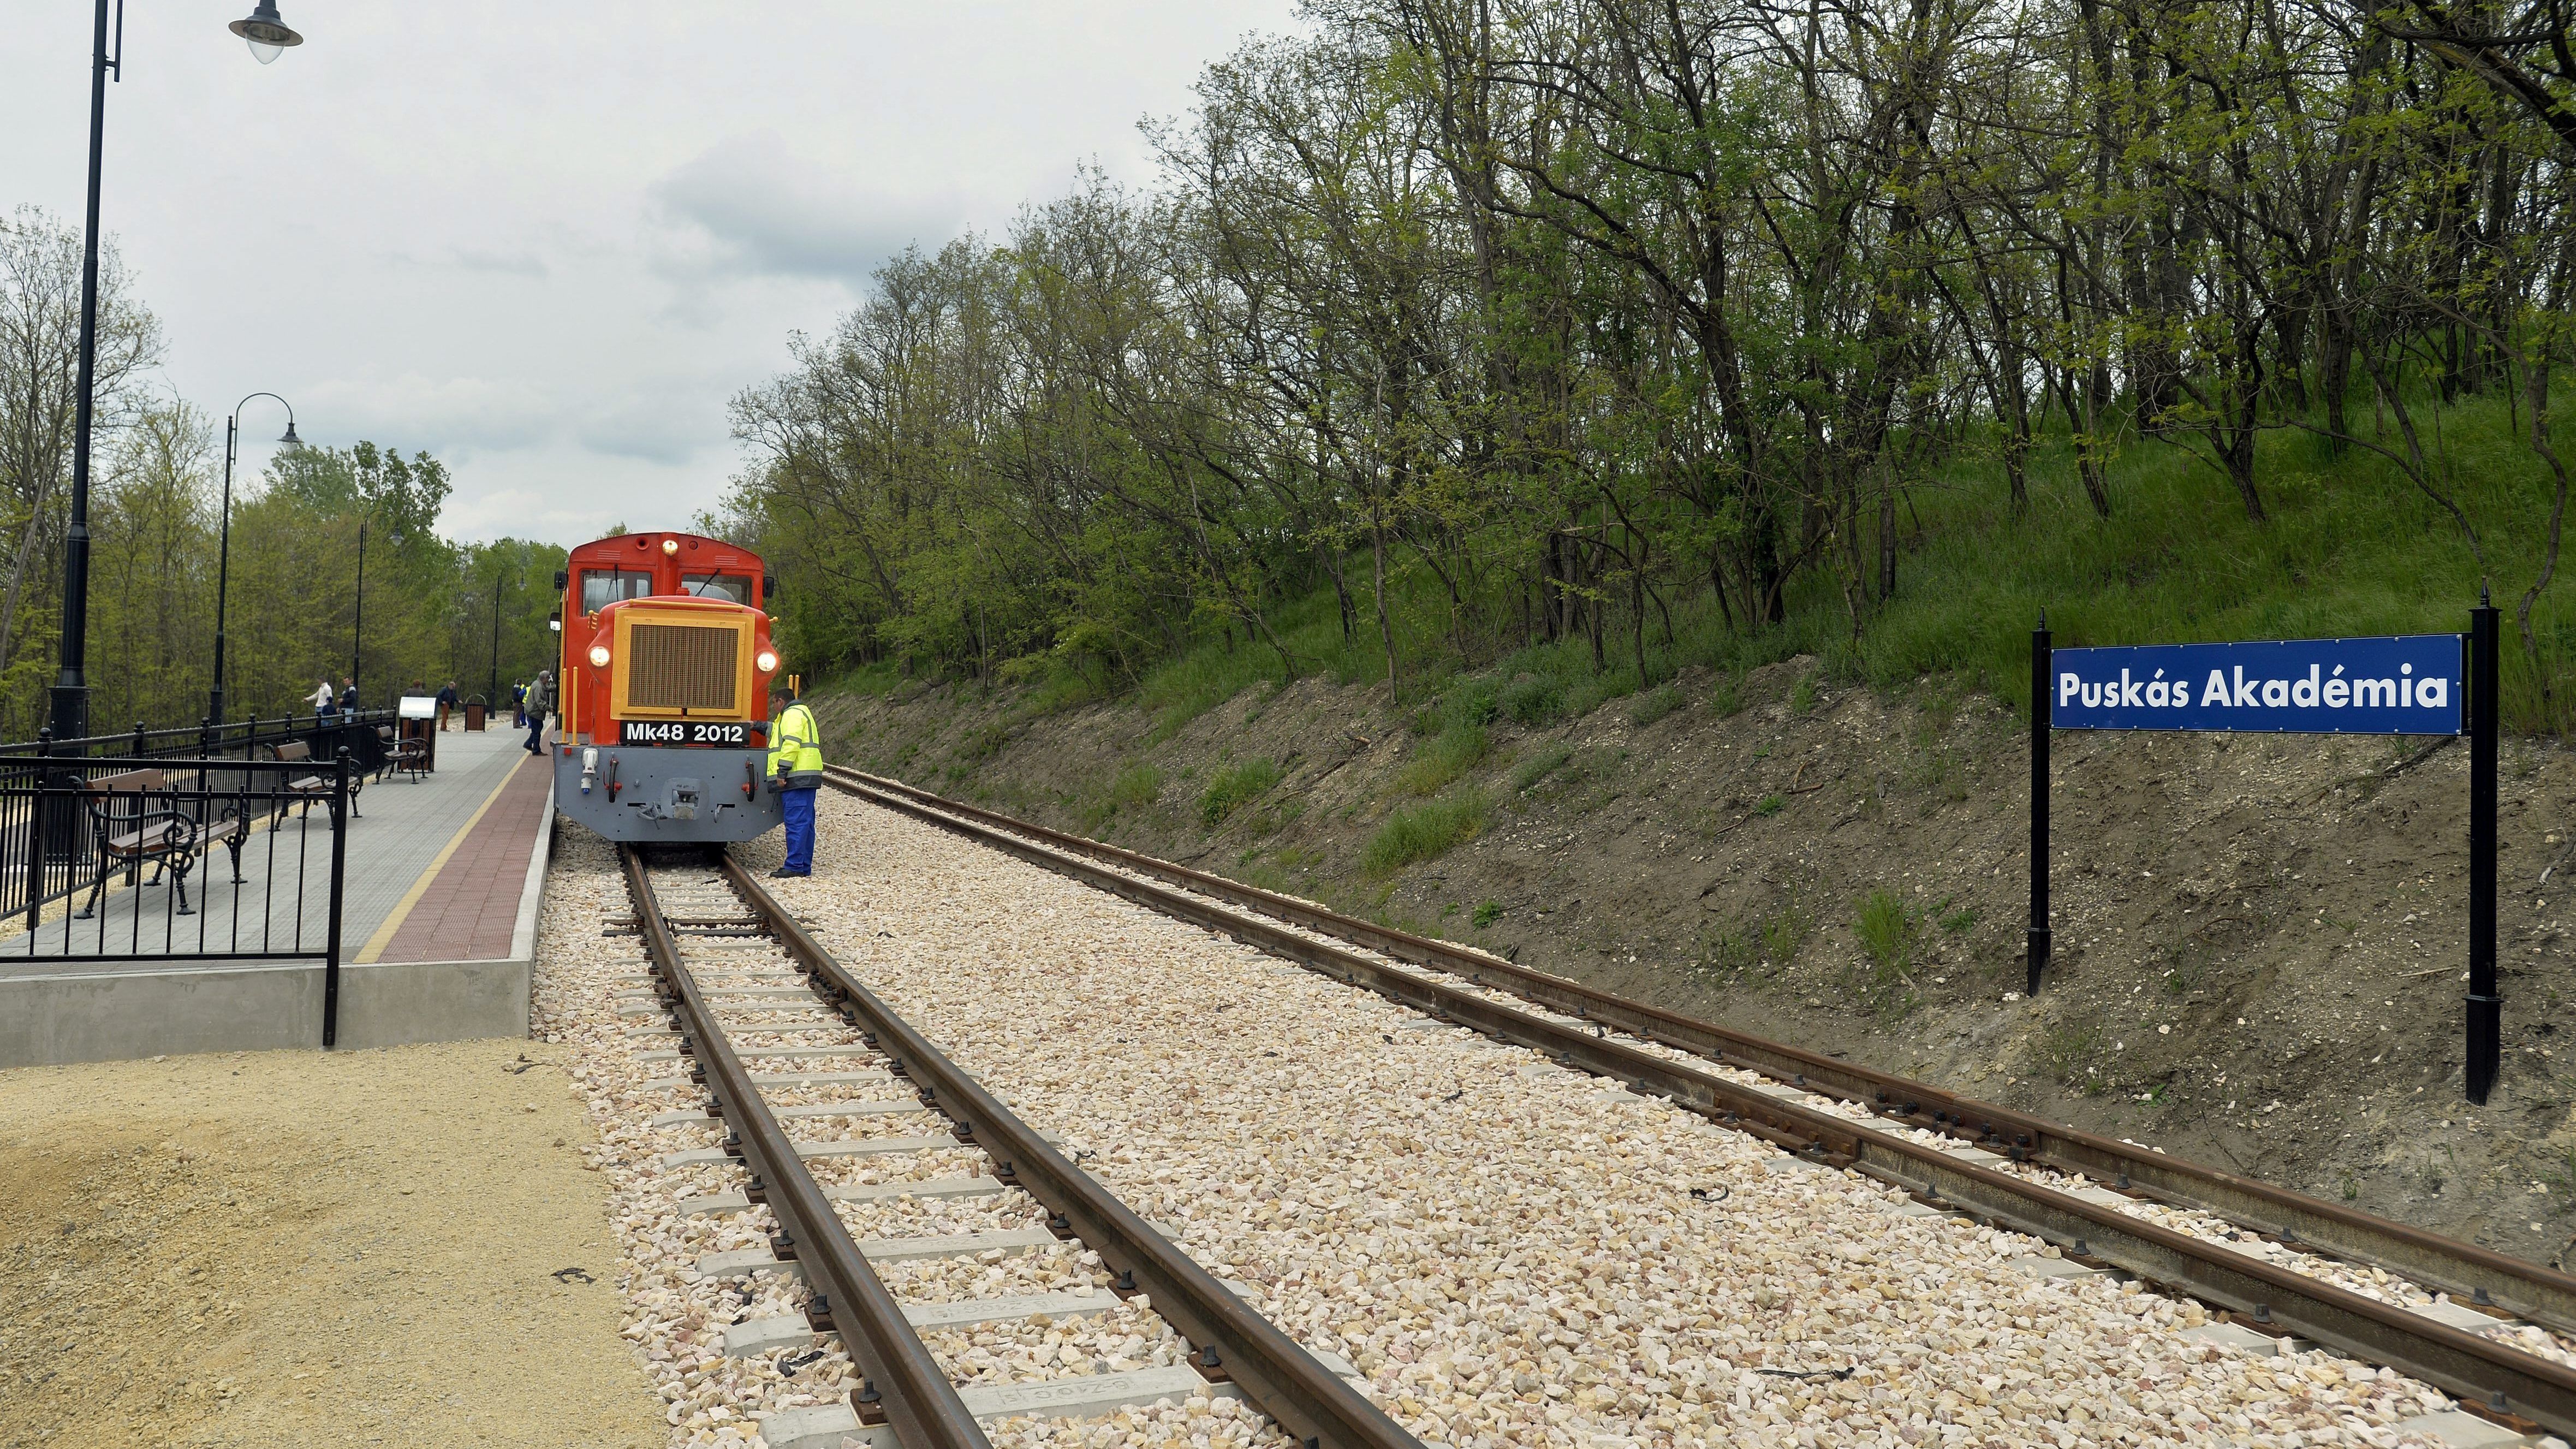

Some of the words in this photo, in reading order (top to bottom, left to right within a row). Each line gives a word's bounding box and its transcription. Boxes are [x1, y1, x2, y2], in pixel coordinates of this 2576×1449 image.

[2060, 668, 2189, 708] Puskás
[2200, 663, 2448, 708] Akadémia
[627, 723, 684, 741] Mk48
[694, 724, 743, 742] 2012
